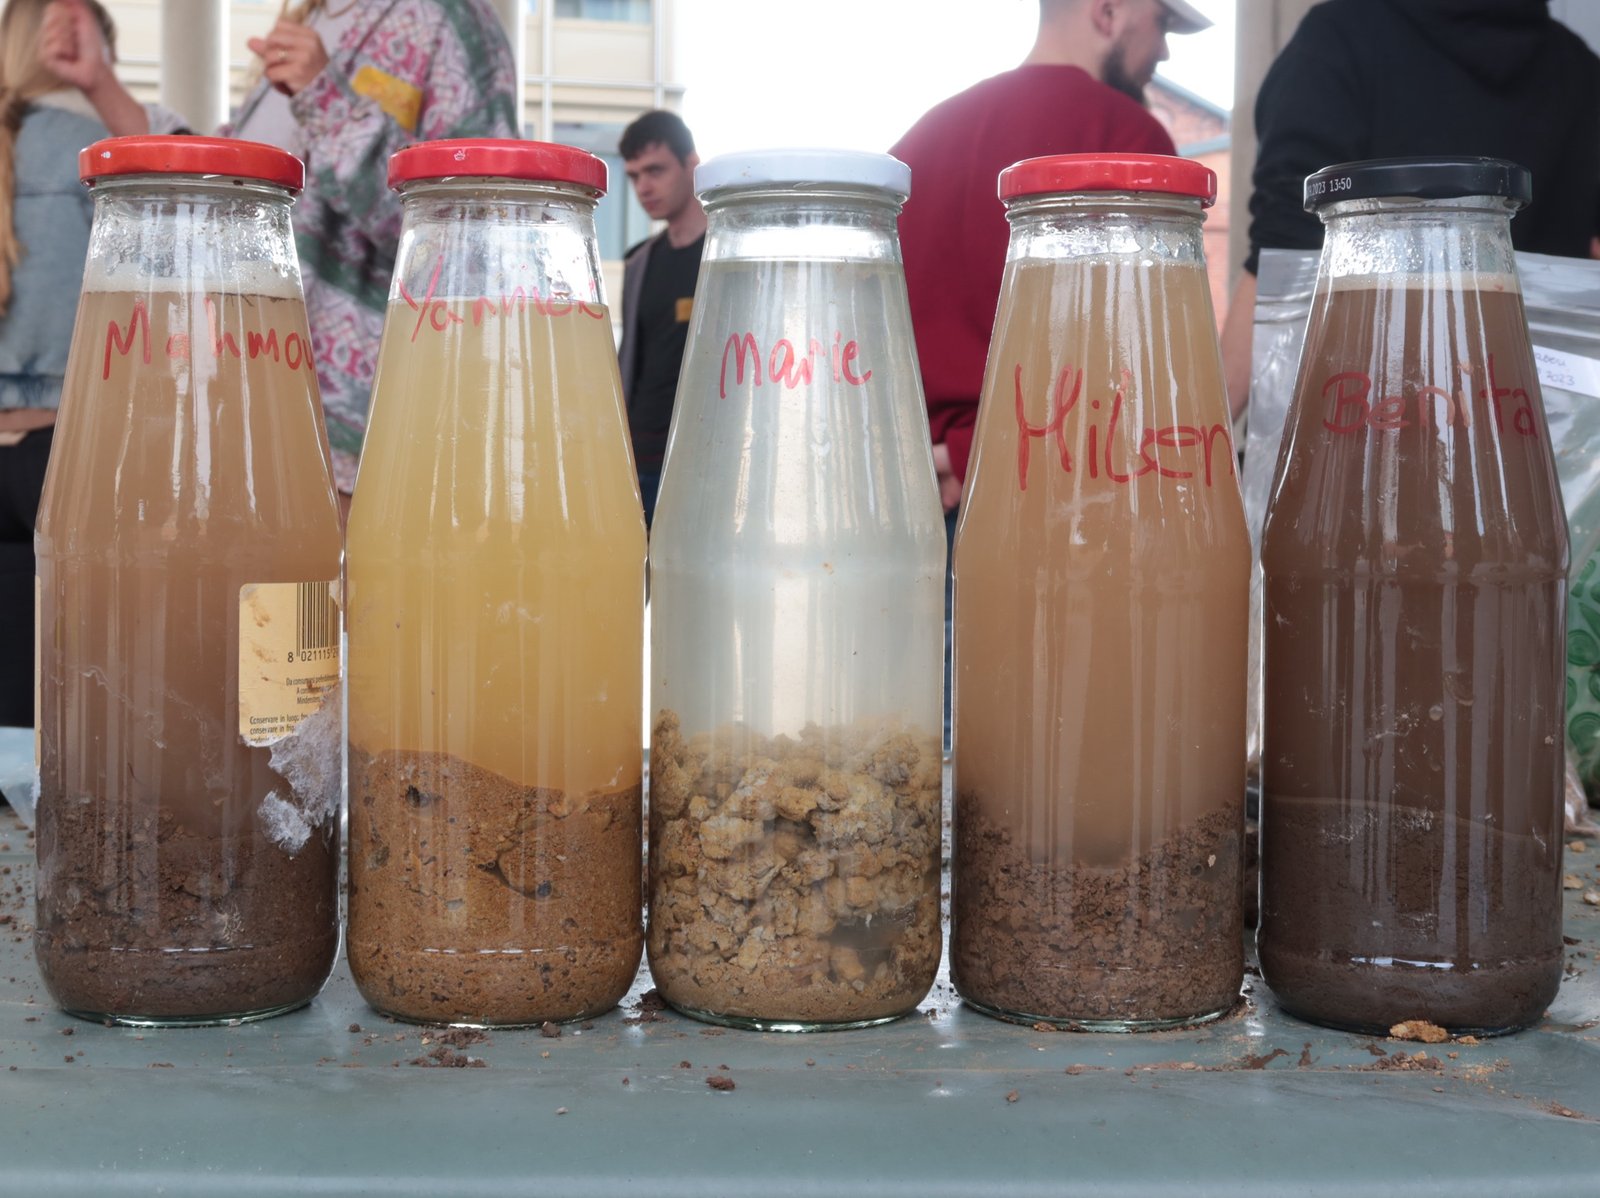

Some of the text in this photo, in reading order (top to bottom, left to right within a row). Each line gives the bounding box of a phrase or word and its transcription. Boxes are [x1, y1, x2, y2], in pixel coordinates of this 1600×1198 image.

[1330, 177, 1352, 192] 13:50
[719, 330, 873, 400] Marie
[1322, 353, 1539, 440] Benita
[287, 652, 294, 663] 8
[249, 715, 279, 725] Conservare
[280, 714, 285, 722] in
[250, 725, 278, 735] conservare
[279, 724, 285, 733] in
